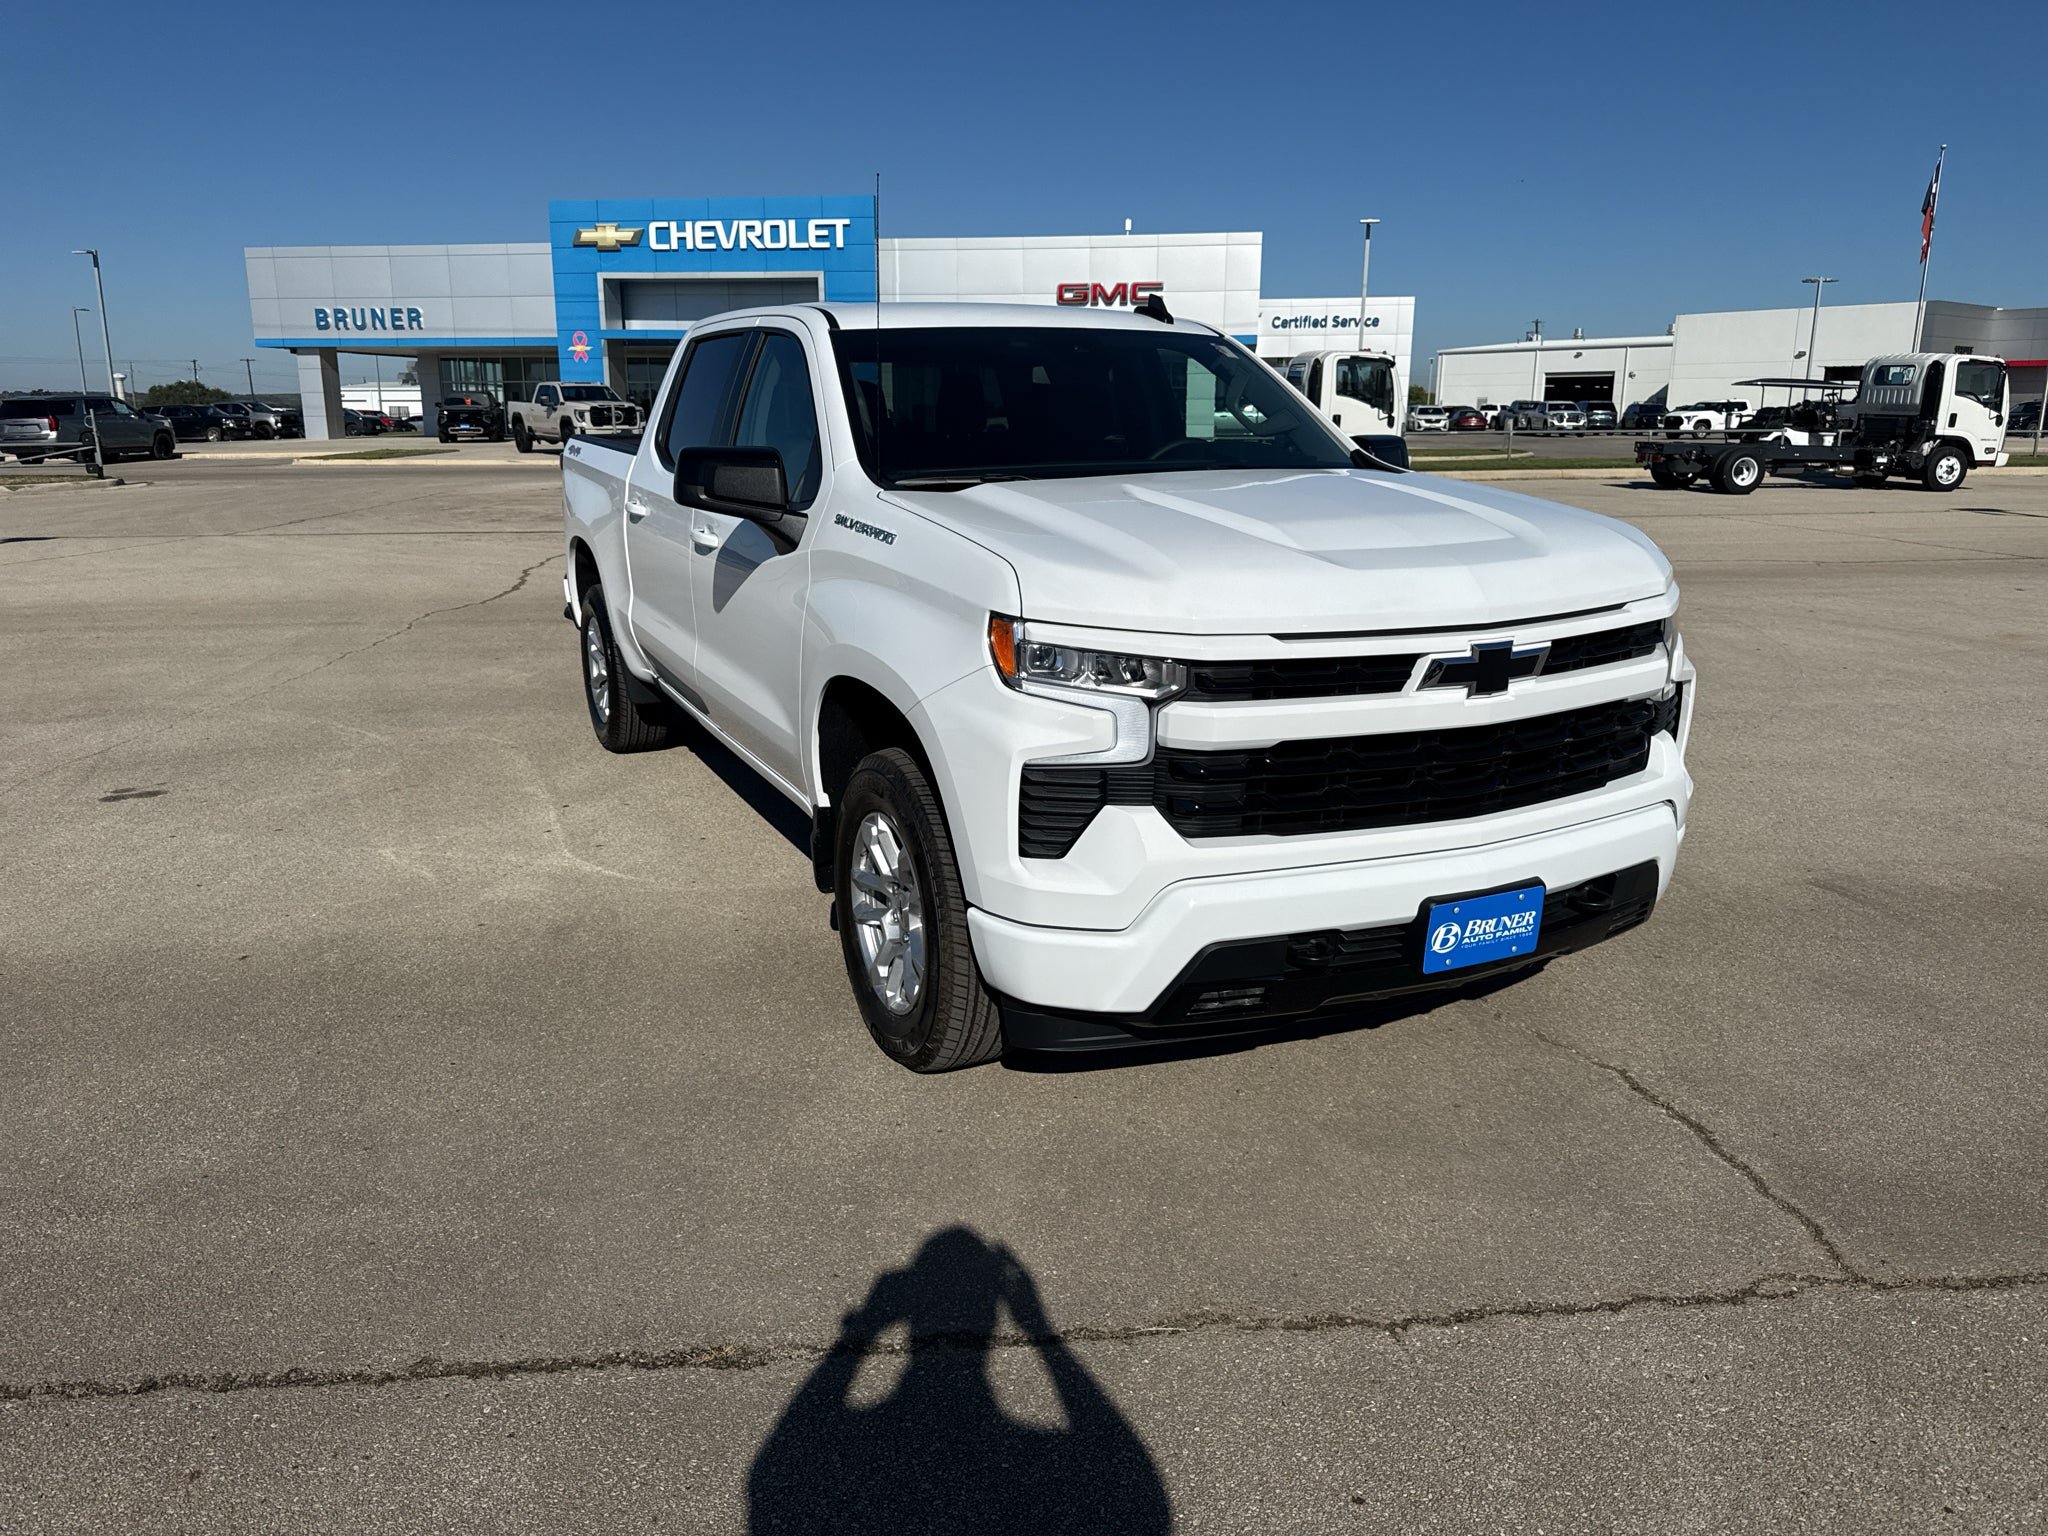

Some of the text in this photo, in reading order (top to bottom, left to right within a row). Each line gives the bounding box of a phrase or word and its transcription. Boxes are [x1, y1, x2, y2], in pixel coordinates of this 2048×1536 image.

[648, 218, 851, 251] CHEVROLET
[1056, 281, 1164, 307] GMC
[314, 307, 425, 331] BRUNER
[1271, 315, 1380, 329] Certified Servce
[1461, 925, 1535, 944] AUTO FAMILY
[1462, 910, 1537, 938] BRUNER
